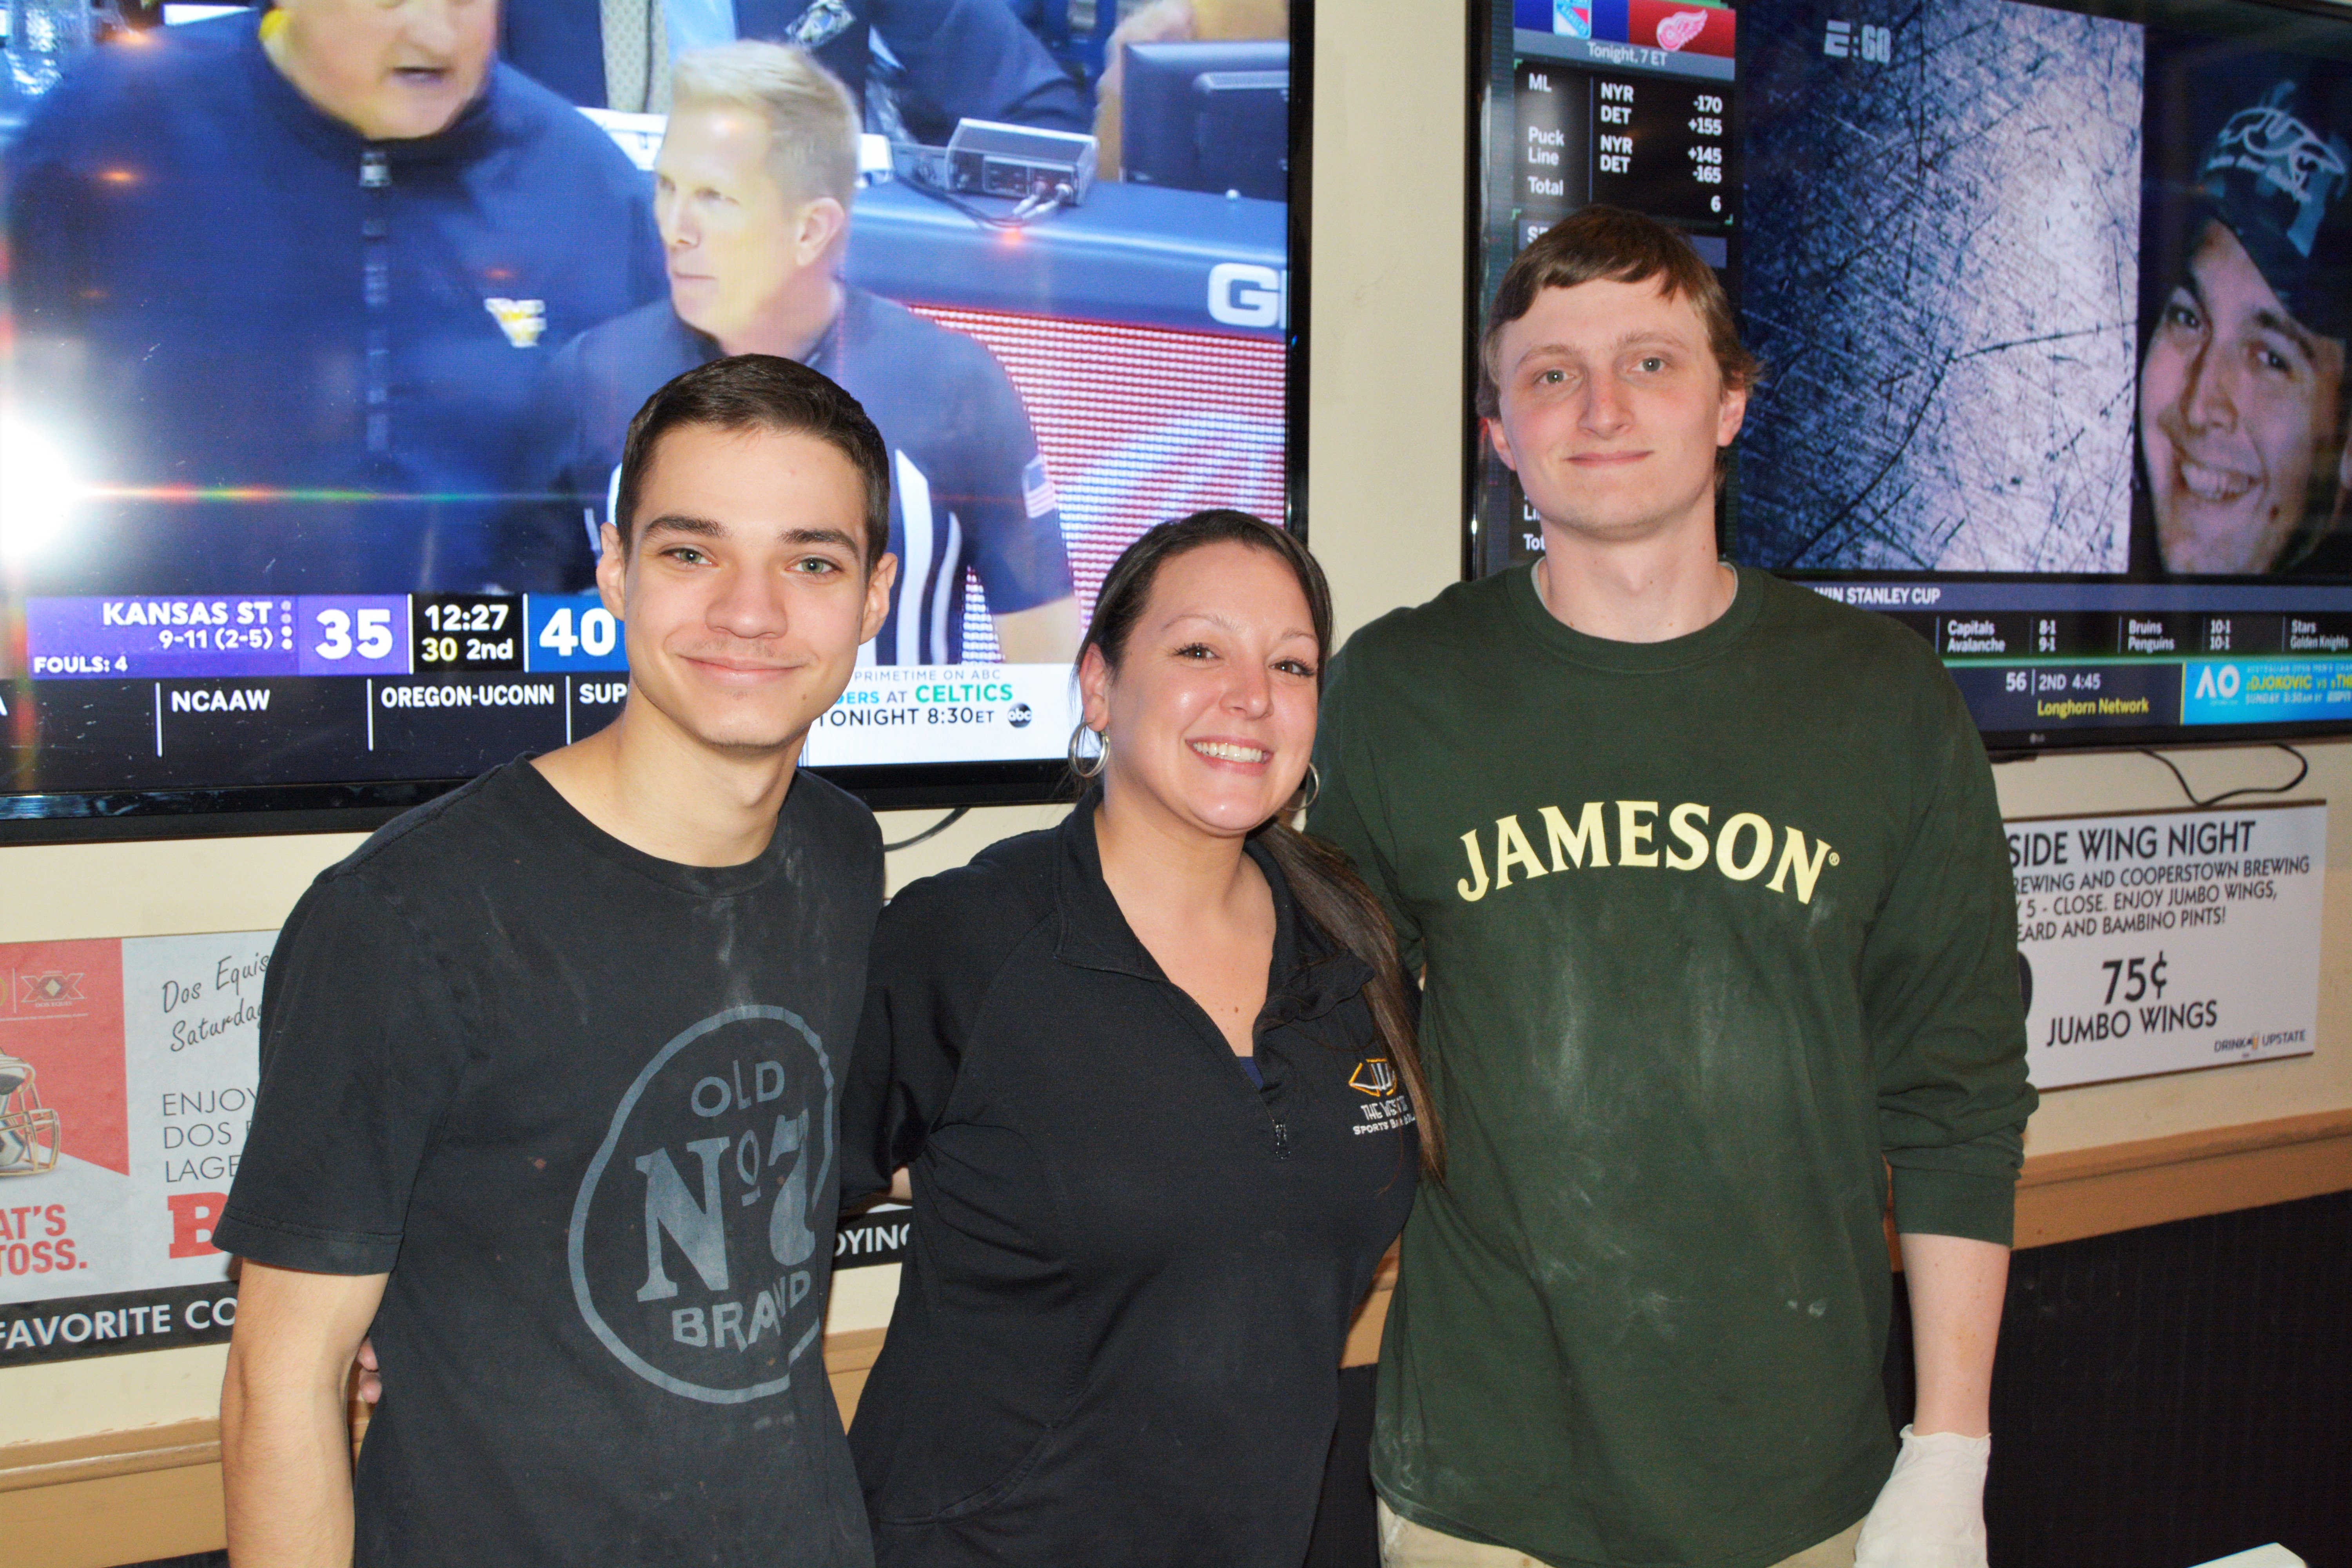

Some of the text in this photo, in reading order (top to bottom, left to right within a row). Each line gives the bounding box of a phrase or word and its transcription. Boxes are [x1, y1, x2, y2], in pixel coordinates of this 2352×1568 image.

[1641, 47, 1648, 64] 7
[1650, 49, 1668, 66] ET
[1529, 73, 1552, 93] ML
[1601, 82, 1722, 114] NYR -170
[1600, 105, 1722, 136] DET +155
[1529, 126, 1564, 147] Puck
[1601, 134, 1722, 164] NYR +145
[1529, 147, 1559, 166] Line
[1600, 154, 1722, 184] DET -165
[1528, 176, 1721, 212] Total 6
[1208, 263, 1287, 329] G
[1846, 587, 1909, 604] STANLEY
[1911, 587, 1941, 604] CUP
[103, 601, 273, 626] KANSAS ST
[425, 604, 509, 632] 12:27
[159, 627, 273, 650] 9-11 (2-5)
[315, 608, 393, 661] 35
[539, 607, 617, 657] 40
[1947, 619, 2316, 637] Capitals 8-1 Bruins 10-1 Stars
[421, 637, 513, 662] 30 2nd
[1947, 634, 2349, 653] Avalanche 9-1 Penguins 10-1 Golden Knights
[33, 655, 128, 673] FOULS: 4
[855, 669, 1001, 682] PRIMETIME ON ABC
[886, 691, 907, 704] AT
[915, 684, 1013, 703] CELTICS
[2005, 672, 2100, 691] 56 2ND 4:45
[171, 689, 270, 713] NCAAW
[381, 684, 555, 708] OREGON-UCONN
[2038, 697, 2149, 718] Longhorn Network
[1007, 710, 1032, 721] abc
[2080, 826, 2156, 860] WING
[2168, 821, 2256, 857] NIGHT
[2080, 872, 2114, 890] AND
[2121, 860, 2238, 886] COOPERSTOWN
[2243, 856, 2309, 876] BREWING
[2027, 900, 2034, 918] 5
[2054, 893, 2107, 916] CLOSE.
[2114, 889, 2163, 910] ENJOY
[2167, 885, 2219, 906] JUMBO
[2225, 881, 2277, 901] WINGS,
[2062, 919, 2096, 938] AND
[2103, 912, 2174, 934] BAMBINO
[2181, 907, 2226, 927] PINTS!
[2102, 951, 2167, 1005] 75¢
[162, 980, 201, 1013] Dos
[171, 998, 262, 1052] Saturda
[2047, 1000, 2217, 1047] JUMBO WINGS
[2214, 1029, 2305, 1052] DRINK UPSTATE
[691, 1060, 784, 1117] OLD
[1361, 1103, 1383, 1120] THE
[164, 1122, 231, 1149] DOS
[1353, 1121, 1389, 1135] SPORTS
[672, 1270, 811, 1353] BRAND
